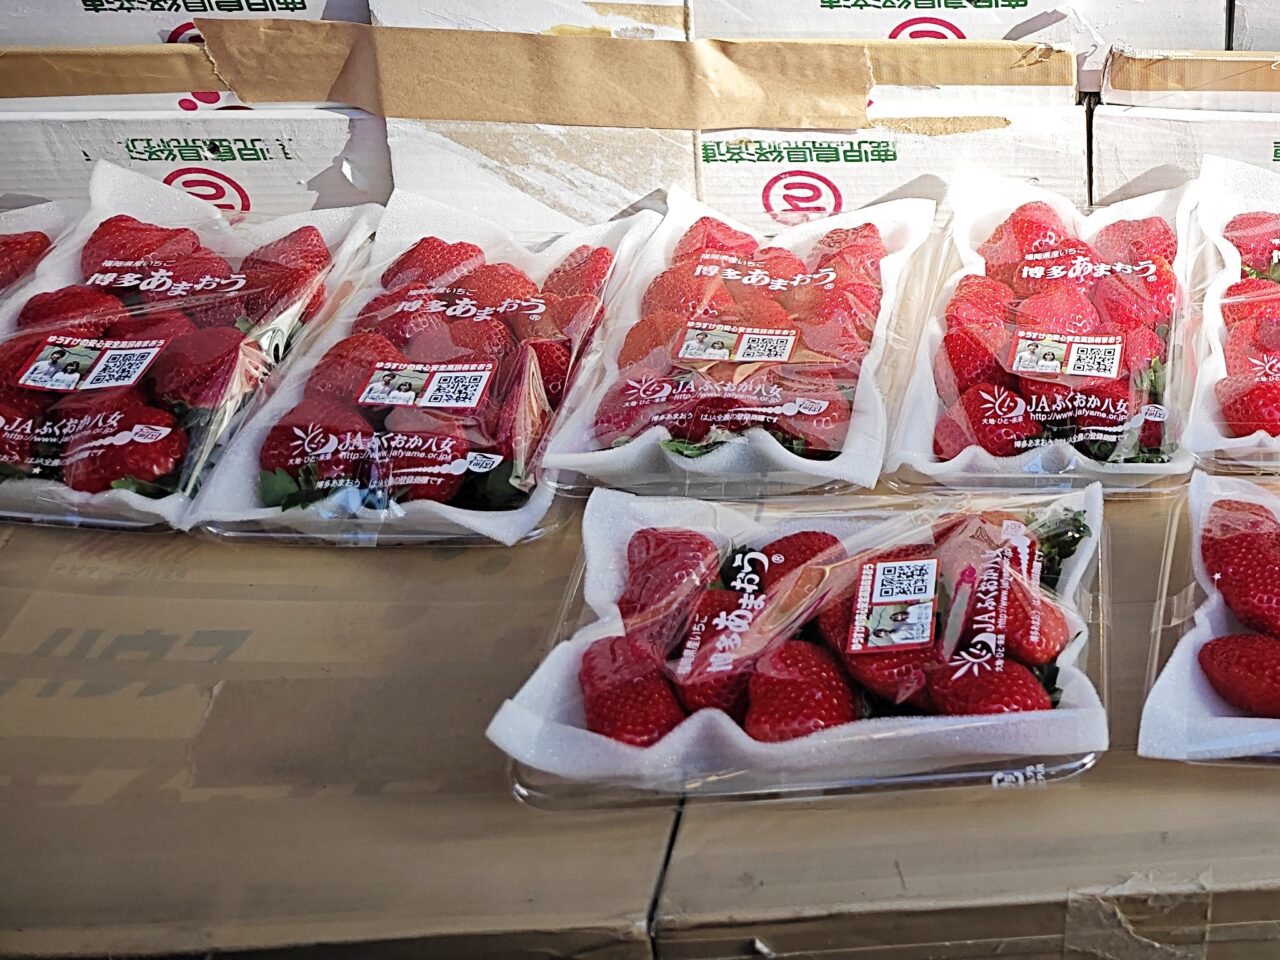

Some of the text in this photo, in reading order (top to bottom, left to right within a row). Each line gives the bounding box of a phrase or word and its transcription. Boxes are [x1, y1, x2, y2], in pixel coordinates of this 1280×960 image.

[701, 139, 898, 164] 鹿児島県経済連
[1021, 256, 1157, 280] 博多あまおう
[1026, 392, 1129, 413] JAふくおか八女
[4, 411, 124, 436] JAふくおか八女
